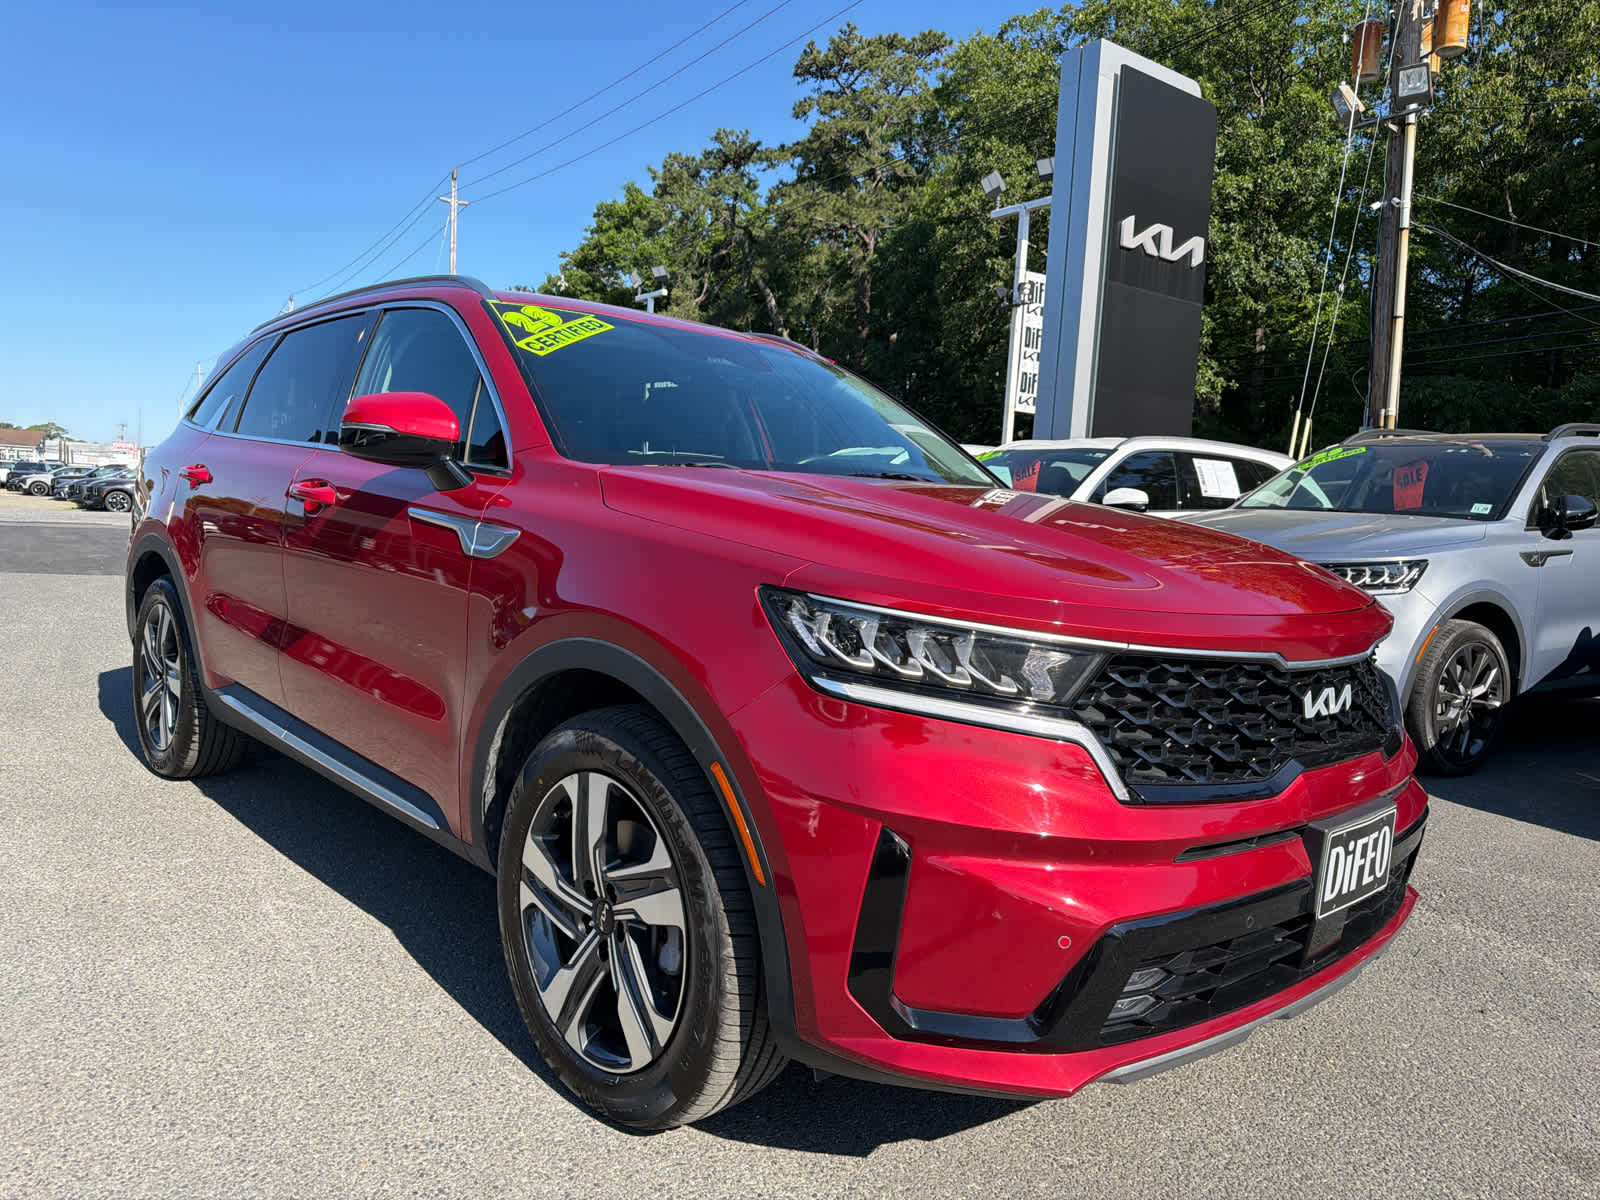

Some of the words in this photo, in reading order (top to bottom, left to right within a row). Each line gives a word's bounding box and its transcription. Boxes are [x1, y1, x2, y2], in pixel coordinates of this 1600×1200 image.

[502, 305, 563, 334] 23
[526, 320, 604, 352] CERTIFIED
[1015, 464, 1036, 482] SALE
[1396, 468, 1423, 489] SALE
